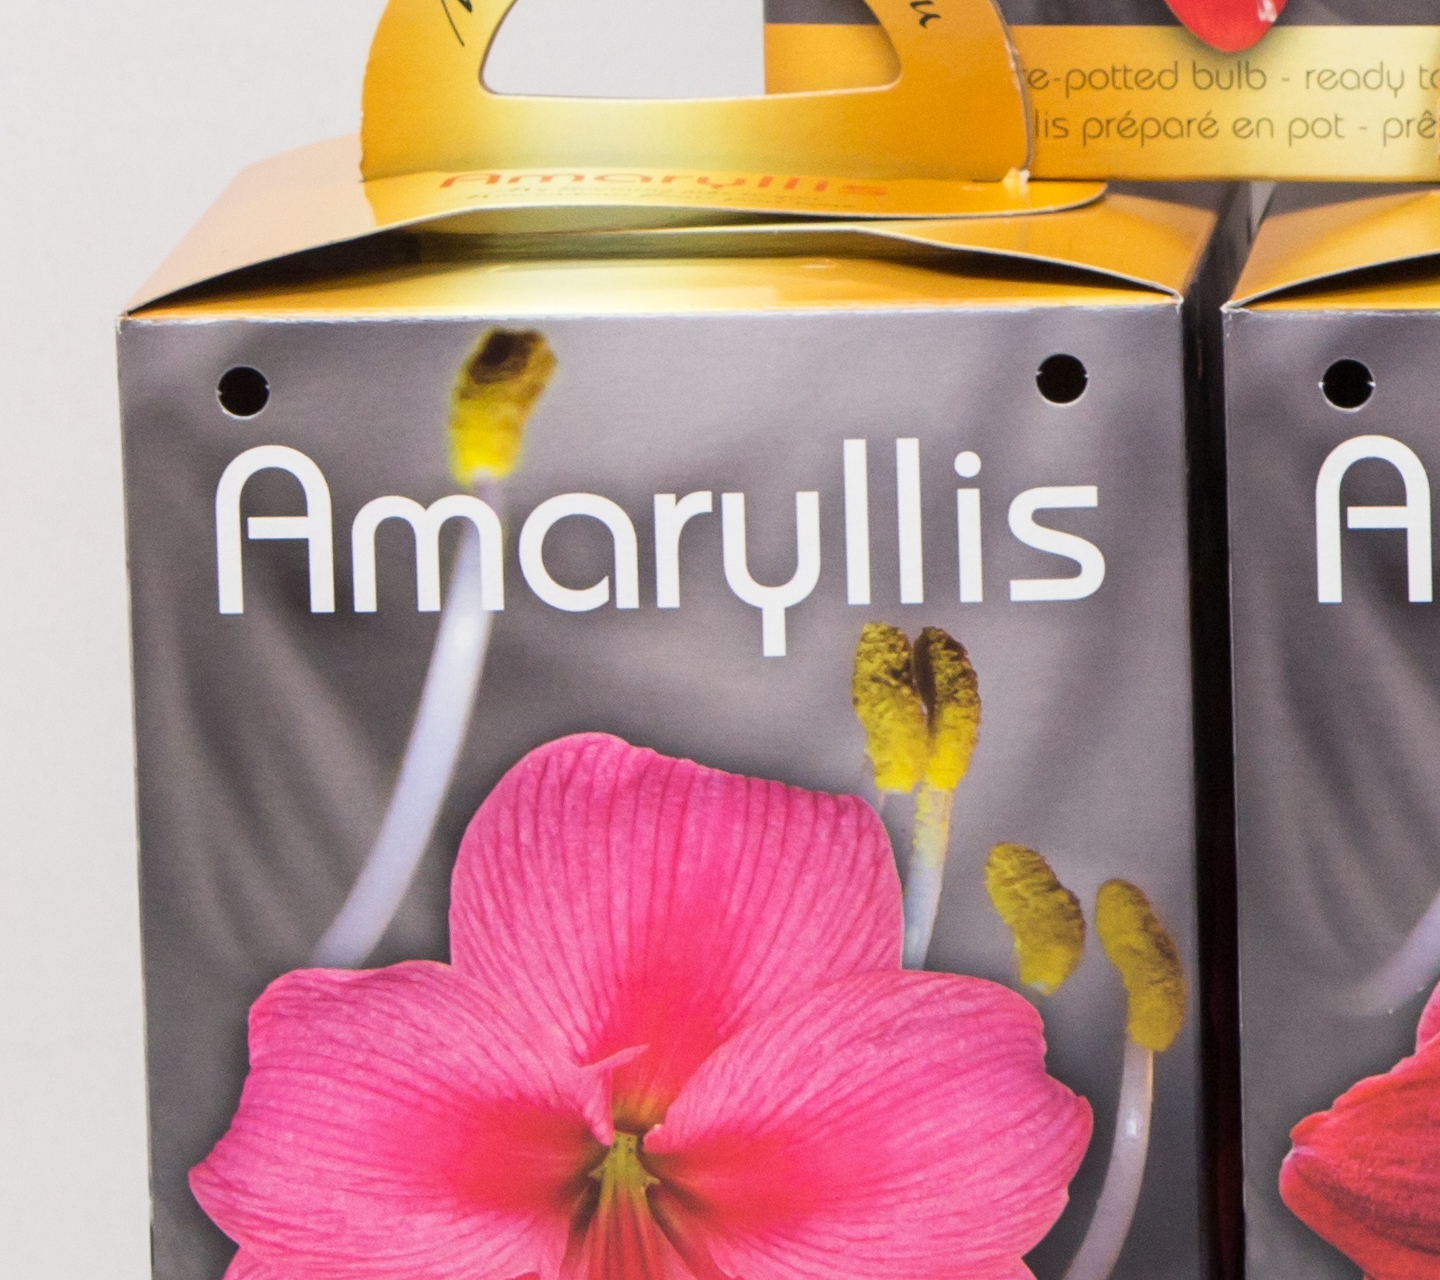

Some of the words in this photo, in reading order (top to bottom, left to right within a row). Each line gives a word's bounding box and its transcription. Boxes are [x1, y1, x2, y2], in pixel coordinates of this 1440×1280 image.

[1026, 61, 1178, 98] e-potted
[1192, 61, 1266, 90] bulb
[1306, 61, 1404, 98] ready
[1082, 111, 1218, 147] préparé
[1232, 118, 1273, 139] en
[1289, 113, 1344, 147] pot
[1383, 109, 1436, 147] prê
[439, 173, 887, 197] Amaryllis
[215, 436, 1107, 658] Amaryllis
